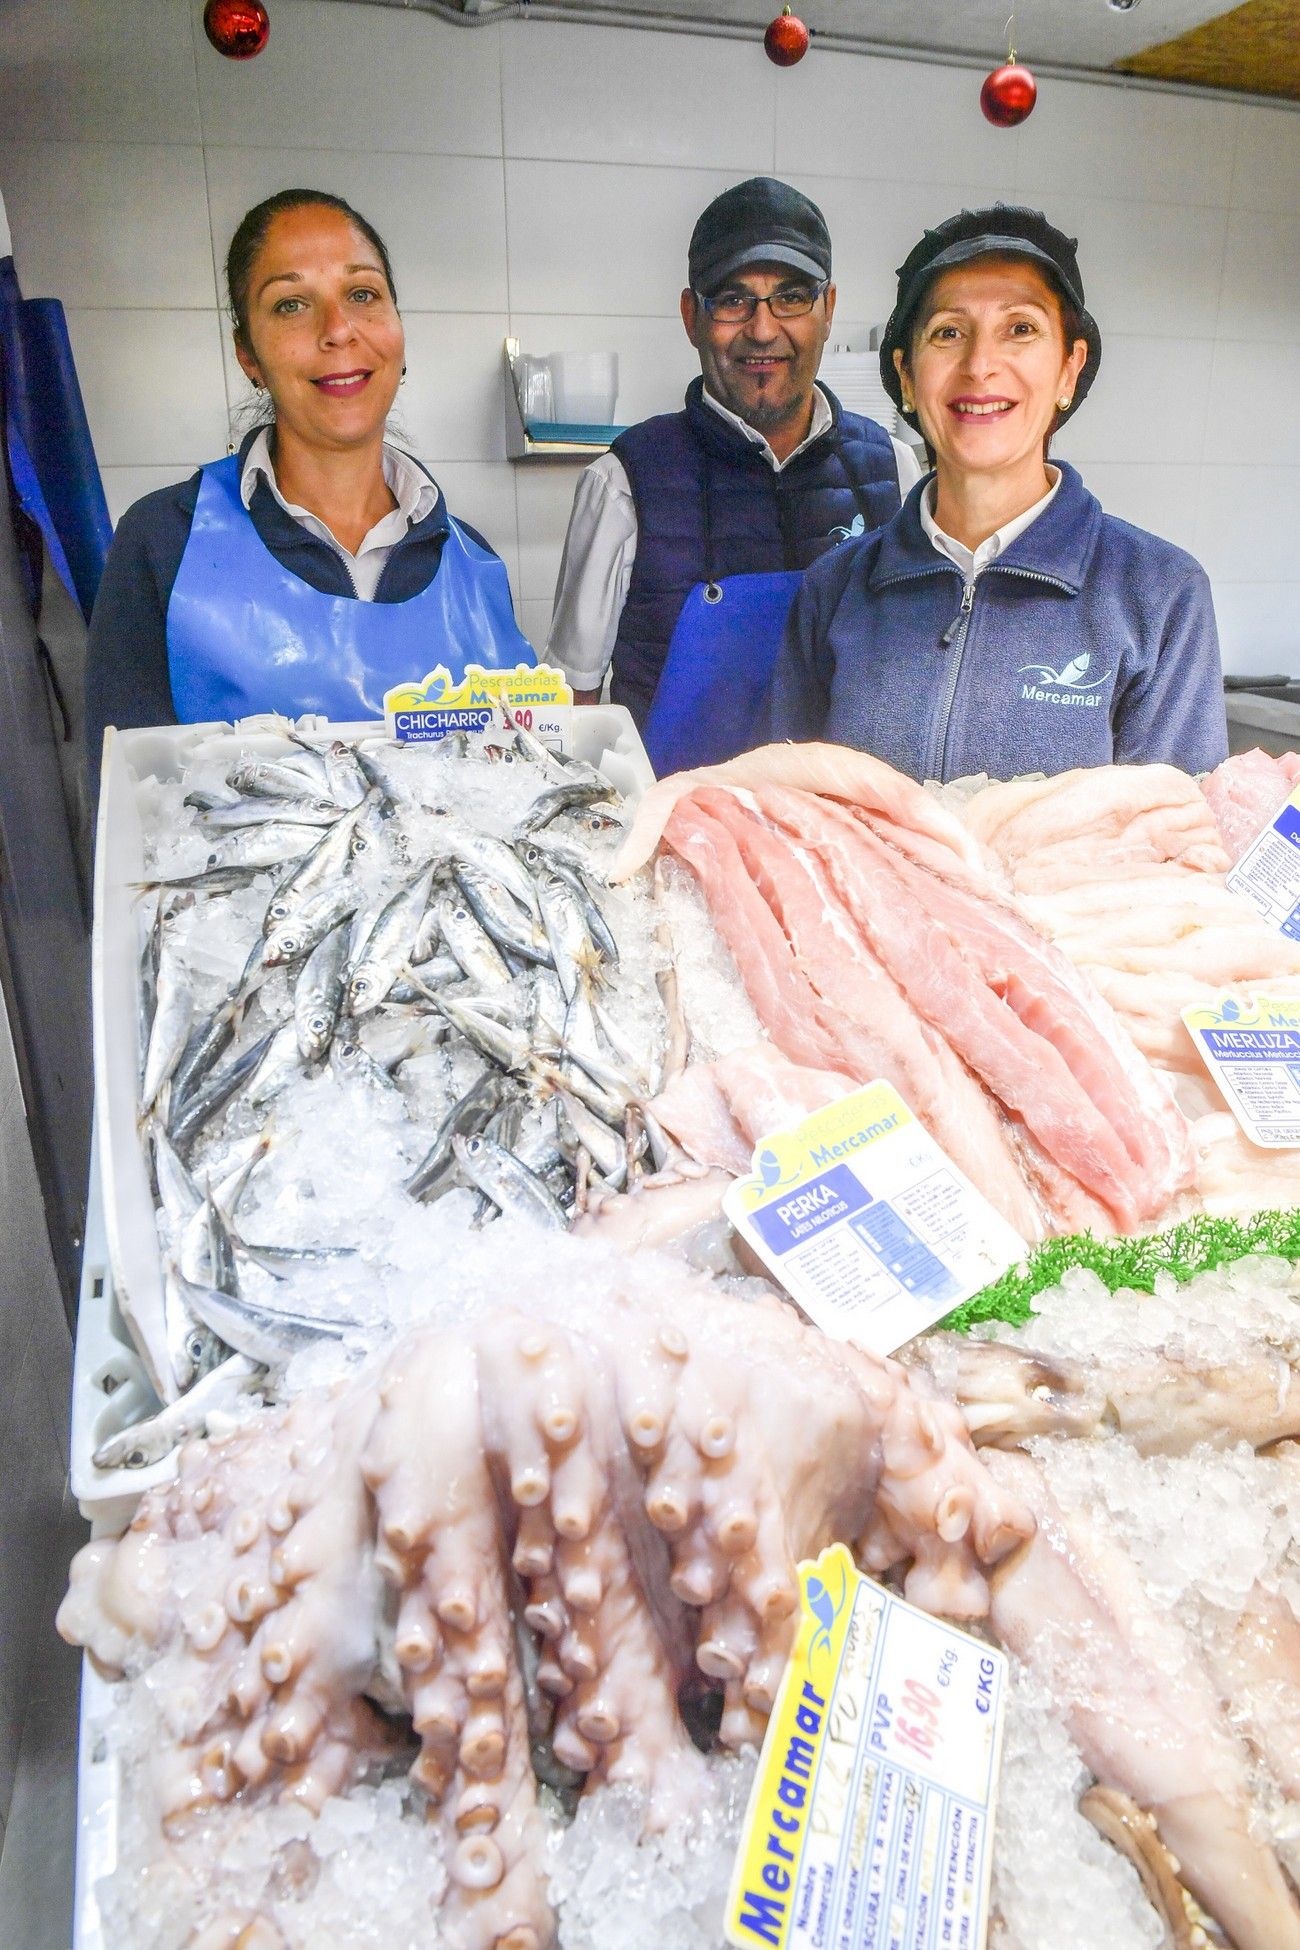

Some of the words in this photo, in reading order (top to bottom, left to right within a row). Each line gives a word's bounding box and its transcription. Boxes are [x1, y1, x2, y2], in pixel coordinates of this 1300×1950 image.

[397, 711, 492, 730] CHICHARRO
[470, 690, 557, 704] Mcamar
[1021, 684, 1102, 706] Mercamar
[407, 731, 444, 739] Trachurus
[1211, 1032, 1300, 1049] MERLUZA
[809, 1112, 899, 1168] Mercamar
[776, 1184, 840, 1226] PERKA
[976, 1658, 994, 1714] €/KG
[871, 1693, 893, 1751] PVP
[739, 1680, 826, 1946] Mercamar
[945, 1807, 962, 1911] OBTENCIÓN
[797, 1866, 816, 1931] Nombre
[811, 1862, 834, 1948] Comercial
